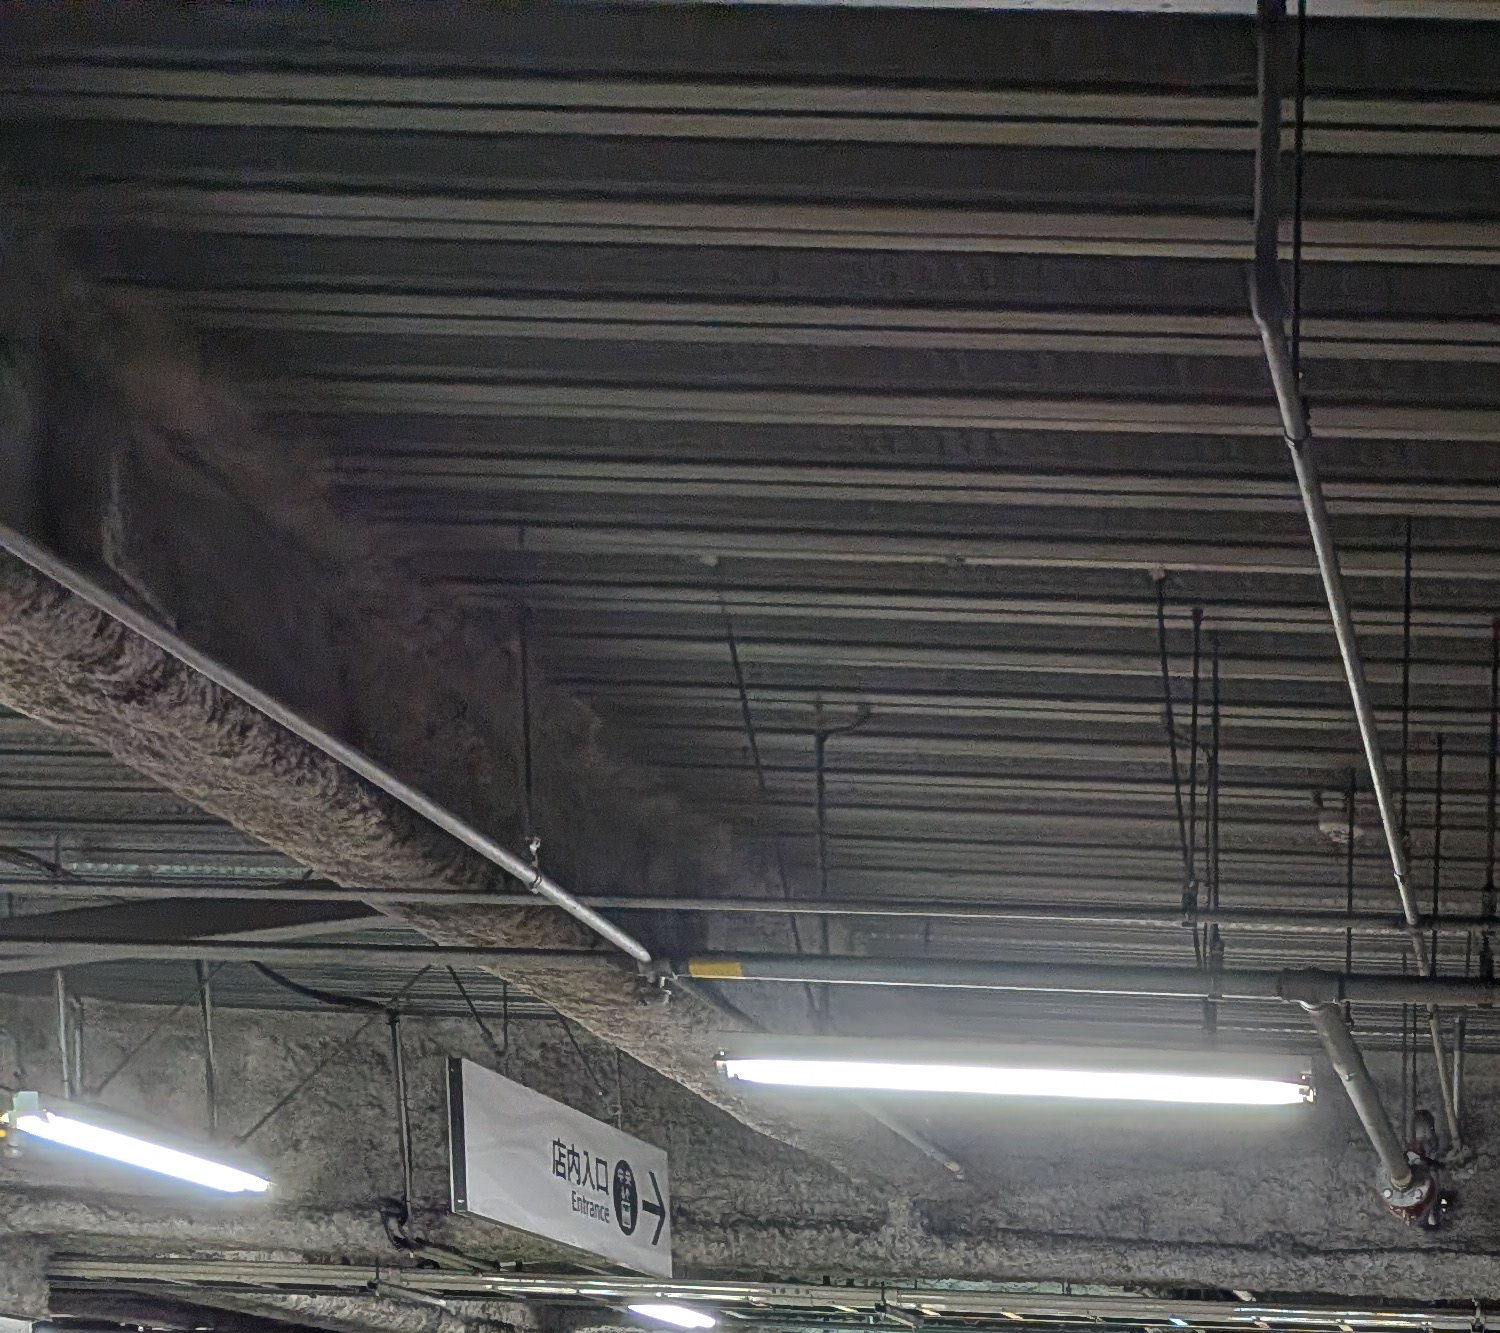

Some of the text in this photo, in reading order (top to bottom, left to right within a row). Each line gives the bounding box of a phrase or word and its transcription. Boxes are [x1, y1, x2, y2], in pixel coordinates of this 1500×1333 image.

[552, 1138, 610, 1195] 店内入口
[571, 1191, 610, 1224] Entrance
